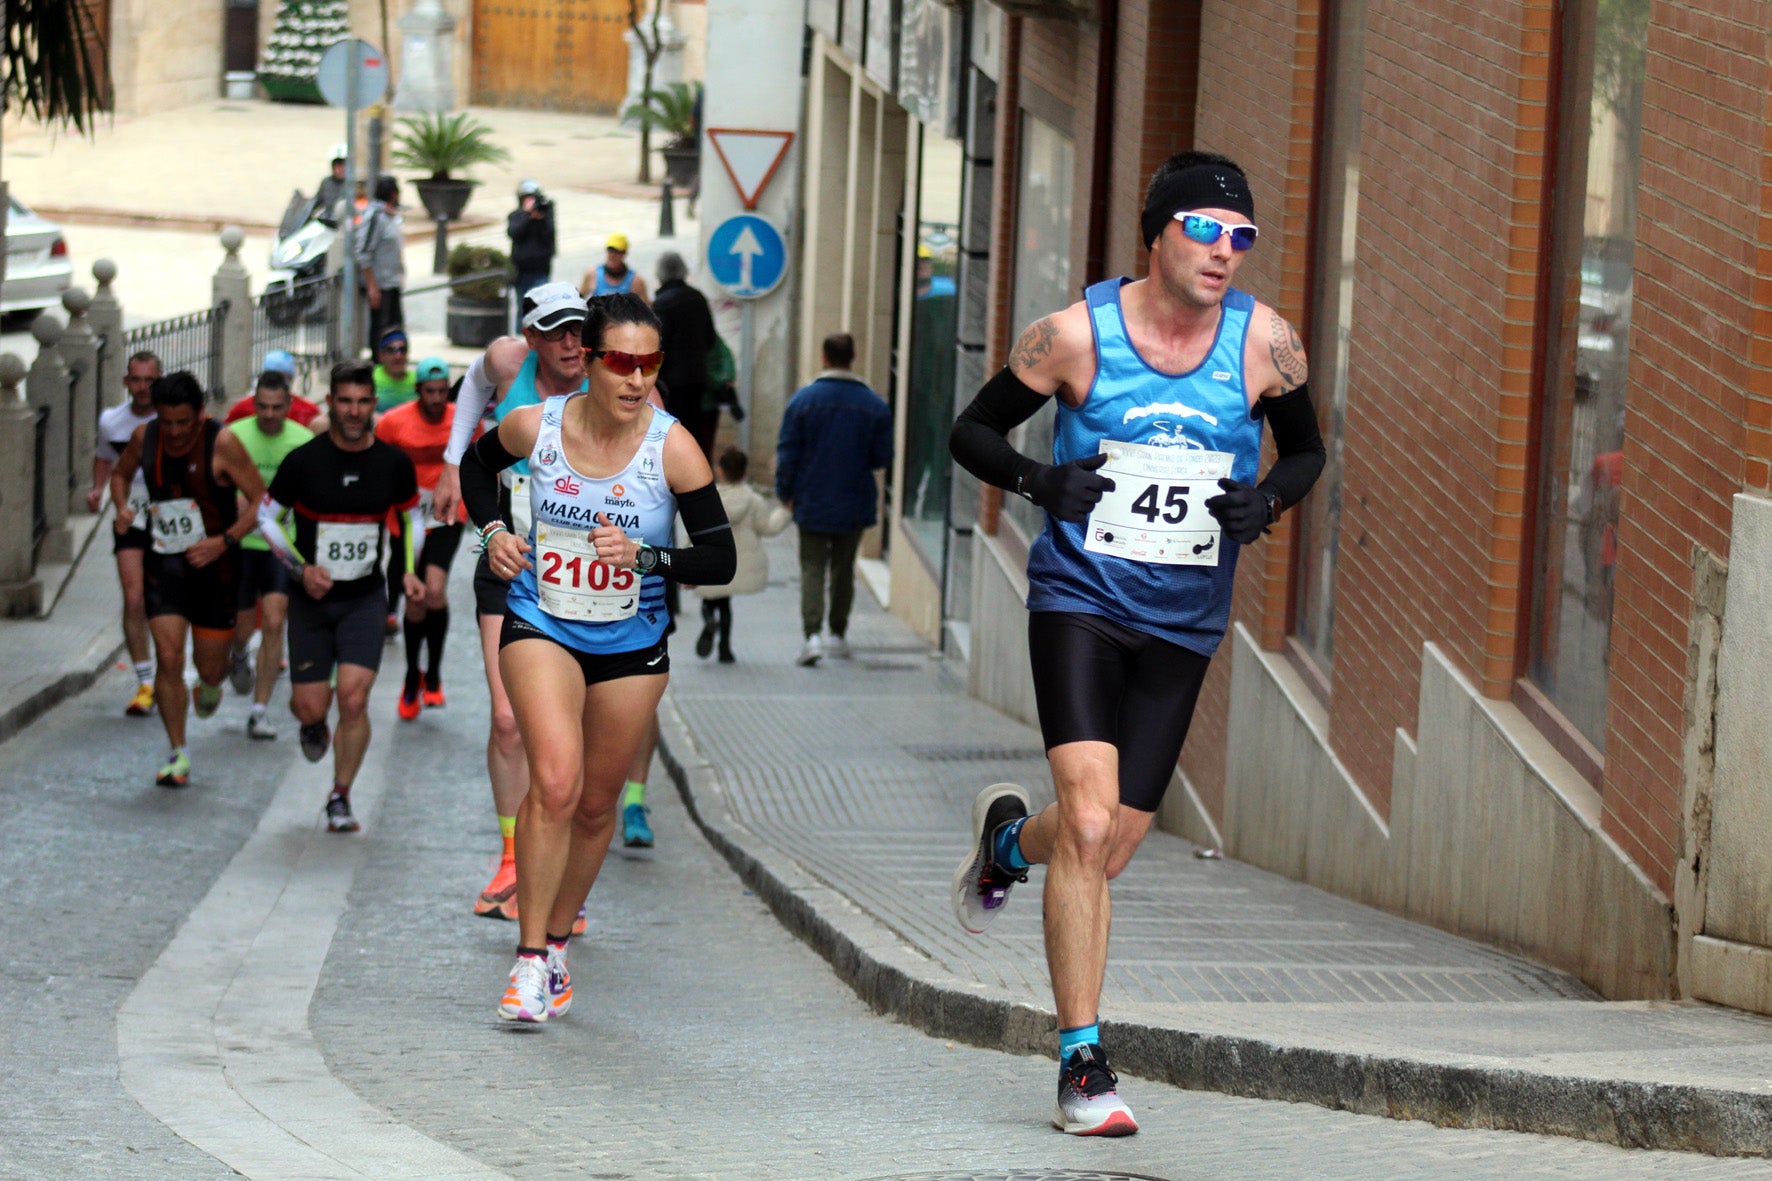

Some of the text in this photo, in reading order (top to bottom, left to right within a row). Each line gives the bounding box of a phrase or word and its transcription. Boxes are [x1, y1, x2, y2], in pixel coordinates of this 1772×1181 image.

[540, 499, 640, 529] MARACENA
[605, 496, 635, 508] mayfo
[1131, 484, 1190, 524] 45
[328, 541, 368, 561] 839
[542, 551, 634, 591] 2105
